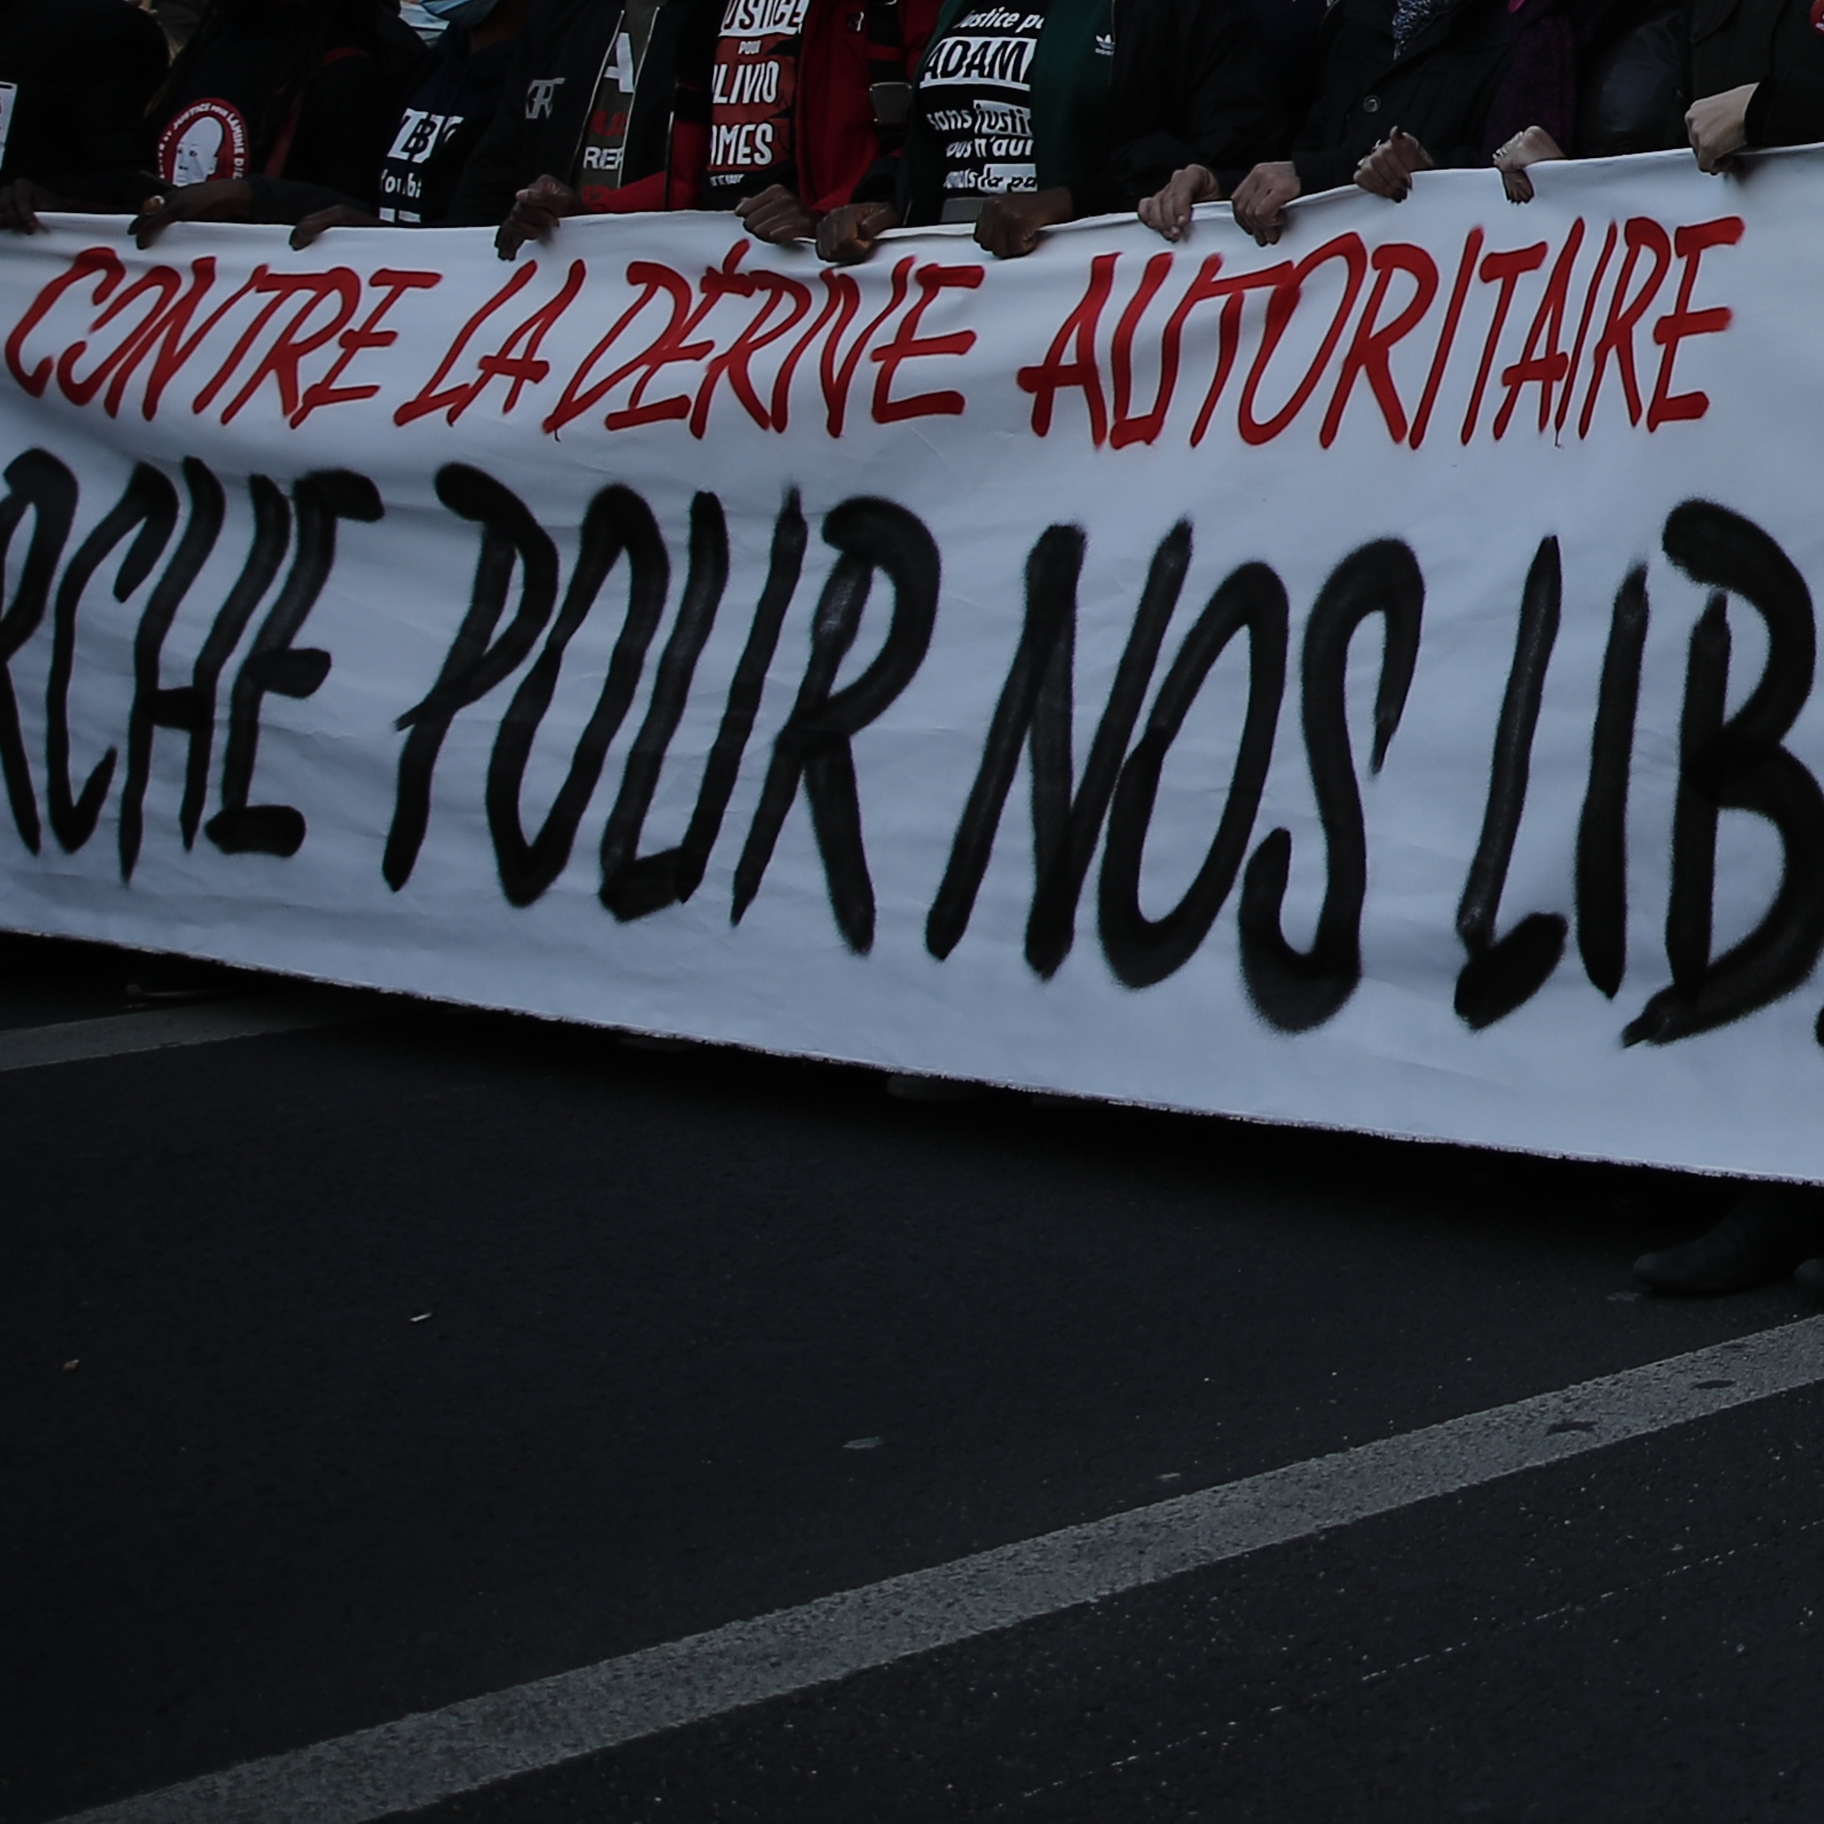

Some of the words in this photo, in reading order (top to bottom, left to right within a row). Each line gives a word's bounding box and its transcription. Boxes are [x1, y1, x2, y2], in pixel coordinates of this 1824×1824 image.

[711, 60, 780, 105] LIVIO
[5, 244, 440, 429] CONTRE
[393, 258, 548, 433] LA
[541, 238, 984, 440] DÉRIVE
[1016, 215, 1745, 451] AUTORITAIRE
[382, 457, 943, 956] POUR
[925, 518, 1427, 1034] NOS
